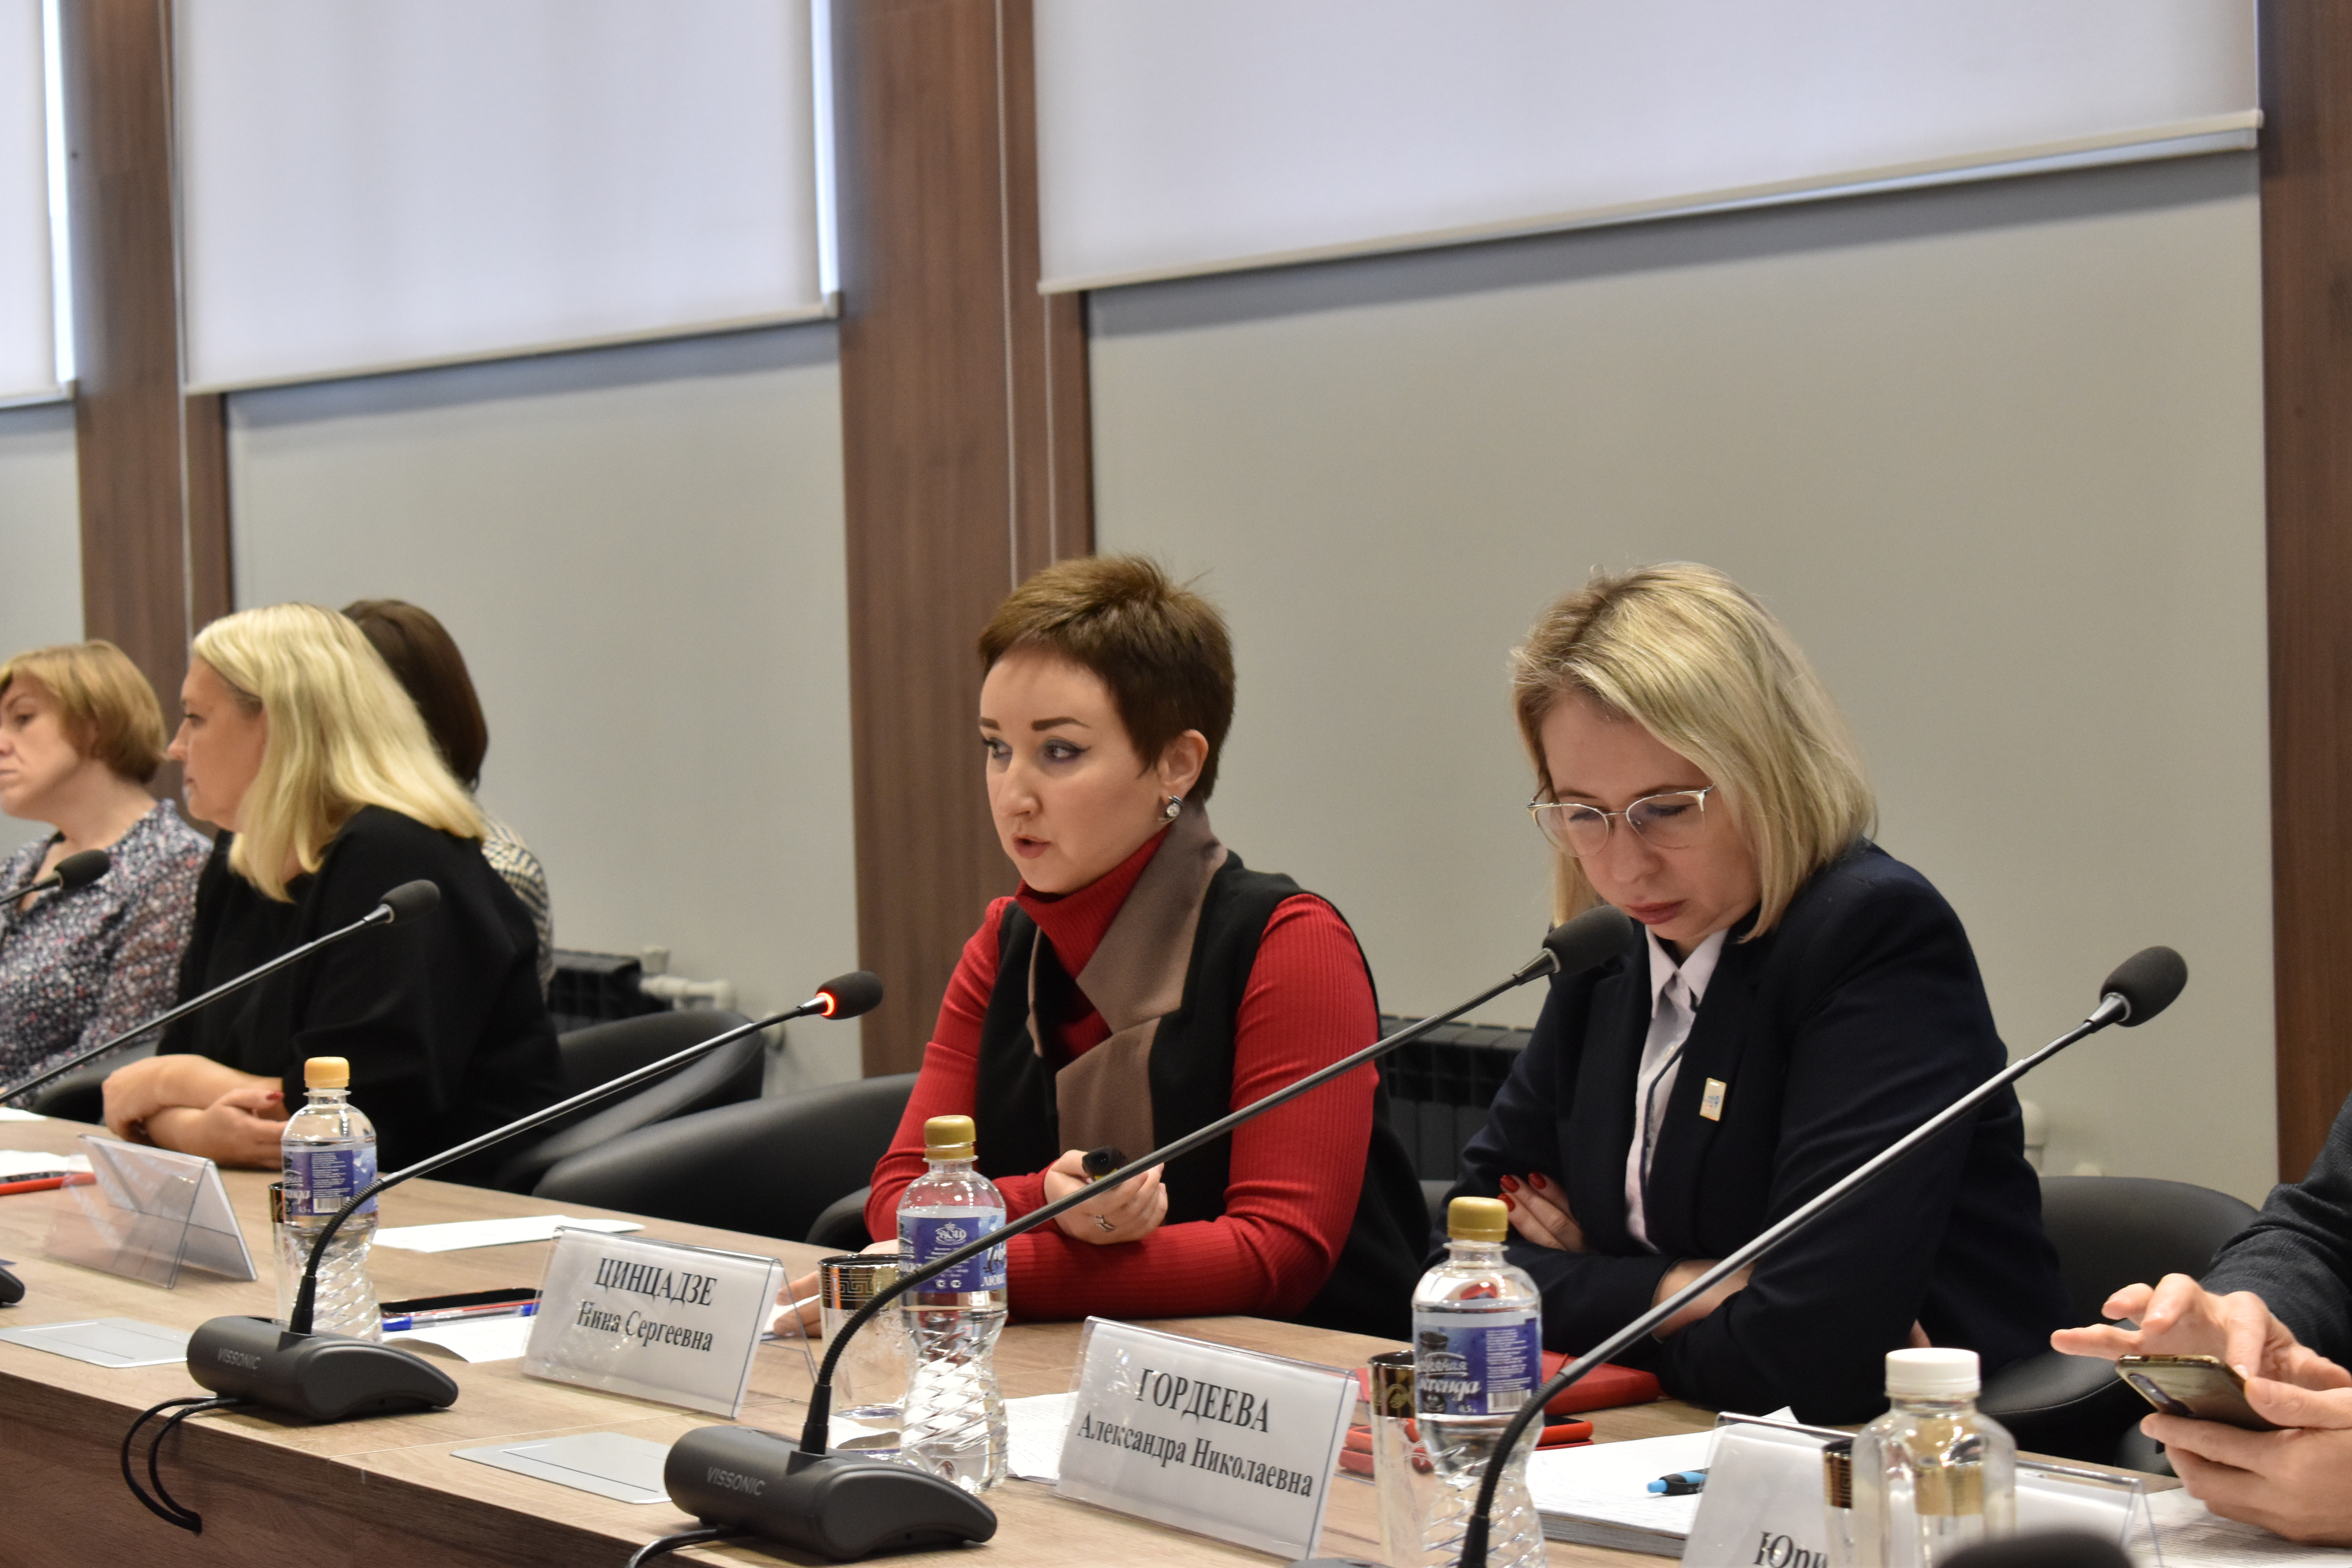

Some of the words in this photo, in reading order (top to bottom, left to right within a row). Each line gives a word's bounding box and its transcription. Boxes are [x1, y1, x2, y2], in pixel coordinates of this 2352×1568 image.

[594, 1258, 717, 1308] ЦИНЦАДЗЕ
[576, 1301, 621, 1333] Нина
[625, 1310, 713, 1352] Сергеевна
[218, 1348, 261, 1369] VISSONIC
[1135, 1368, 1269, 1433] ГОРДЕЕВА
[1076, 1411, 1187, 1468] Александра
[1190, 1437, 1314, 1497] Николаевна
[707, 1467, 766, 1496] VISSONIC
[1753, 1531, 1828, 1568] Юри
